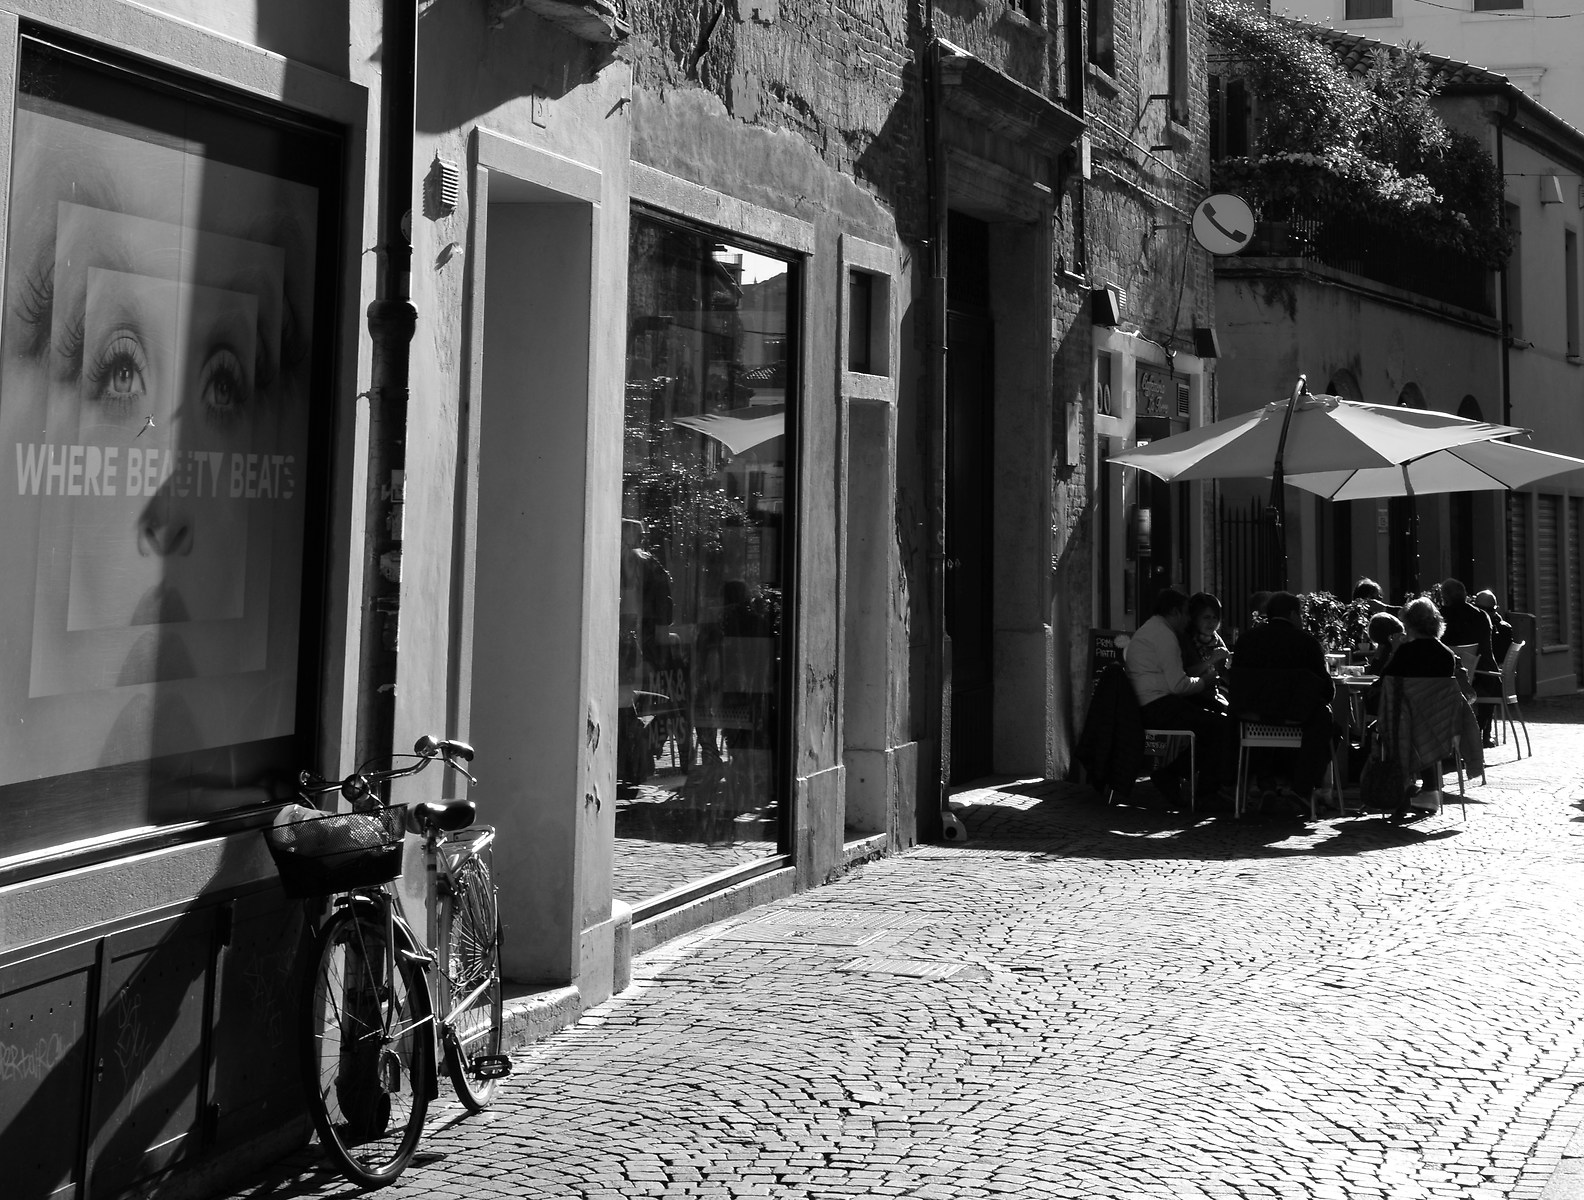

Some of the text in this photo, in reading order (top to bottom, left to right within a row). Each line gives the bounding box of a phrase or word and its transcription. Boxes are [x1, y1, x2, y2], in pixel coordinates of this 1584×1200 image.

[16, 443, 296, 500] WHERE BEAUTY BEATS
